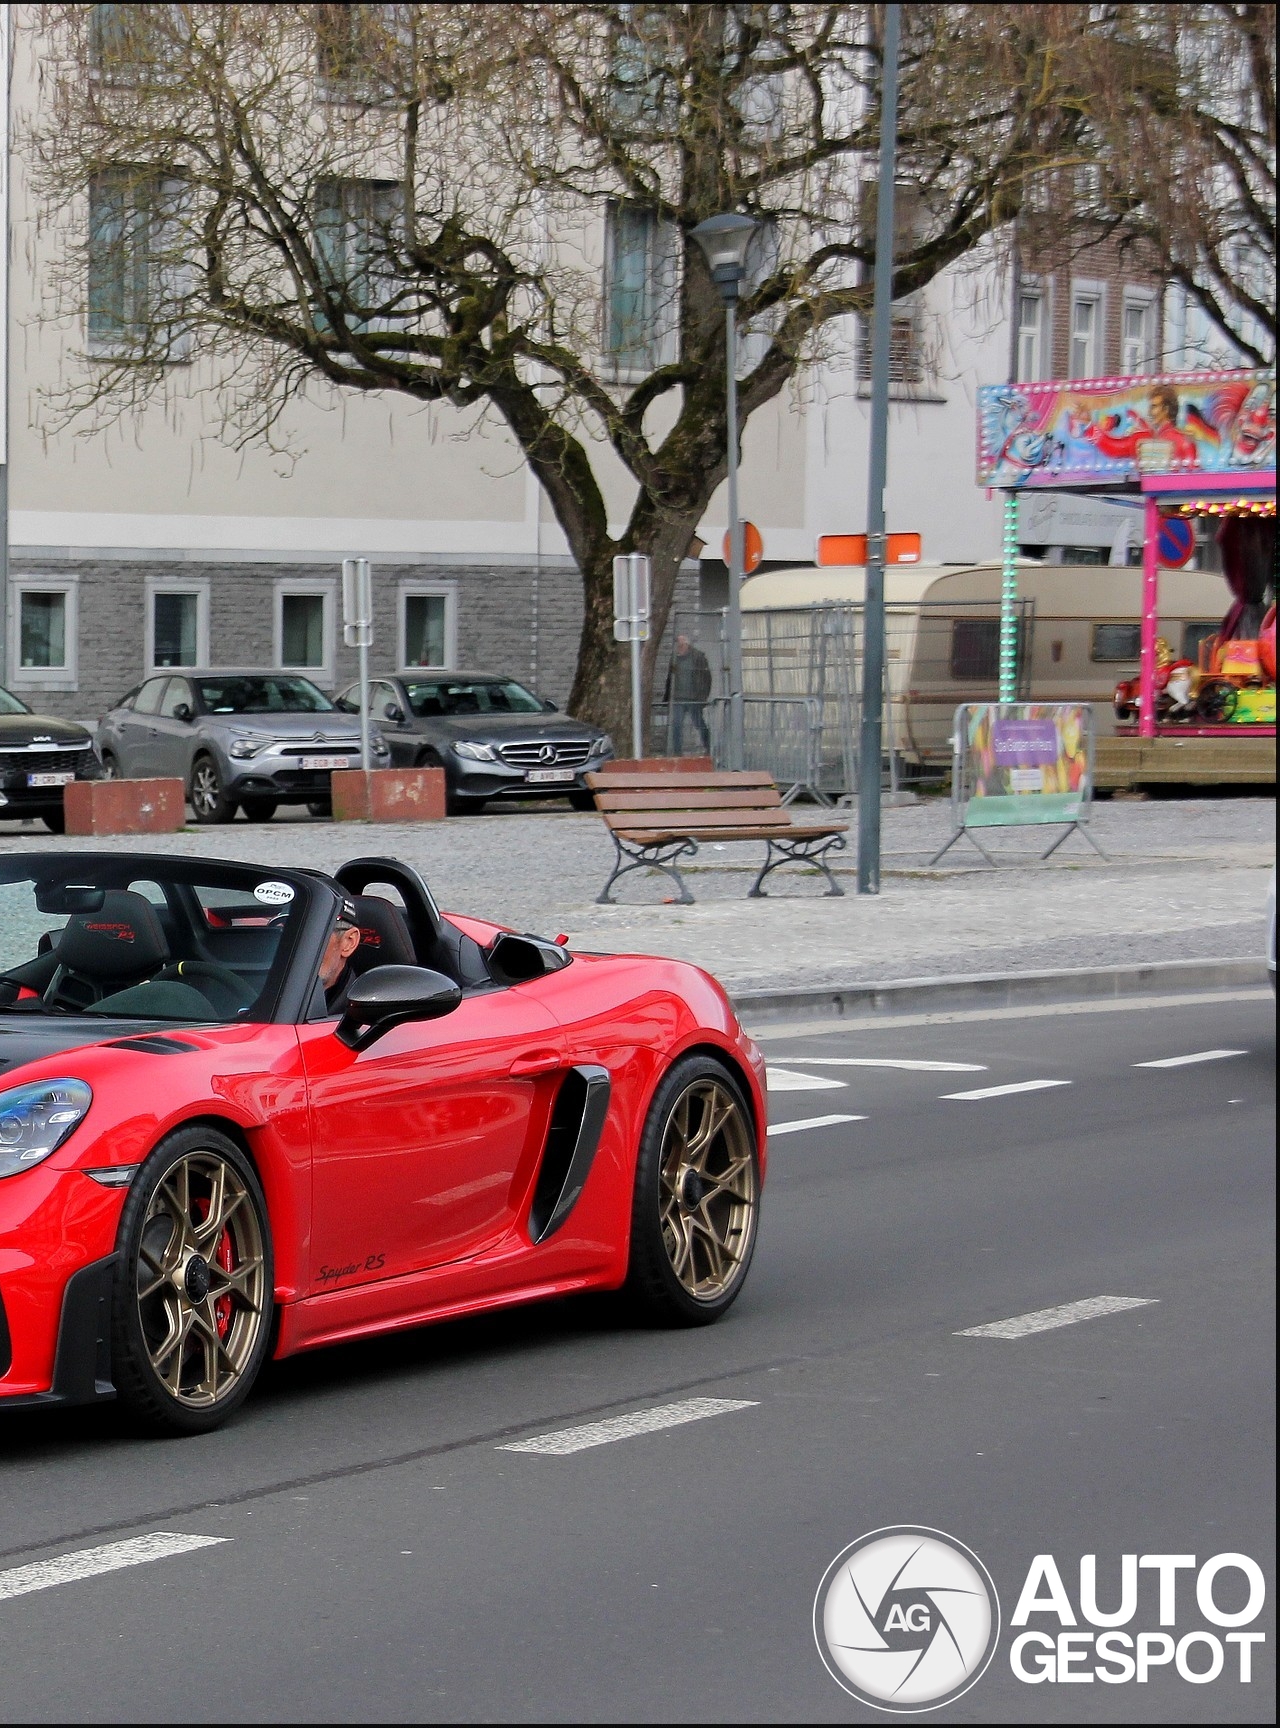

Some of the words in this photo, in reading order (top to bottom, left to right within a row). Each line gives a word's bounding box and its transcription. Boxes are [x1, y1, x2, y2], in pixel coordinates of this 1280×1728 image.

[256, 888, 292, 899] OPCM
[315, 1262, 363, 1286] Spyder
[363, 1253, 386, 1272] RS
